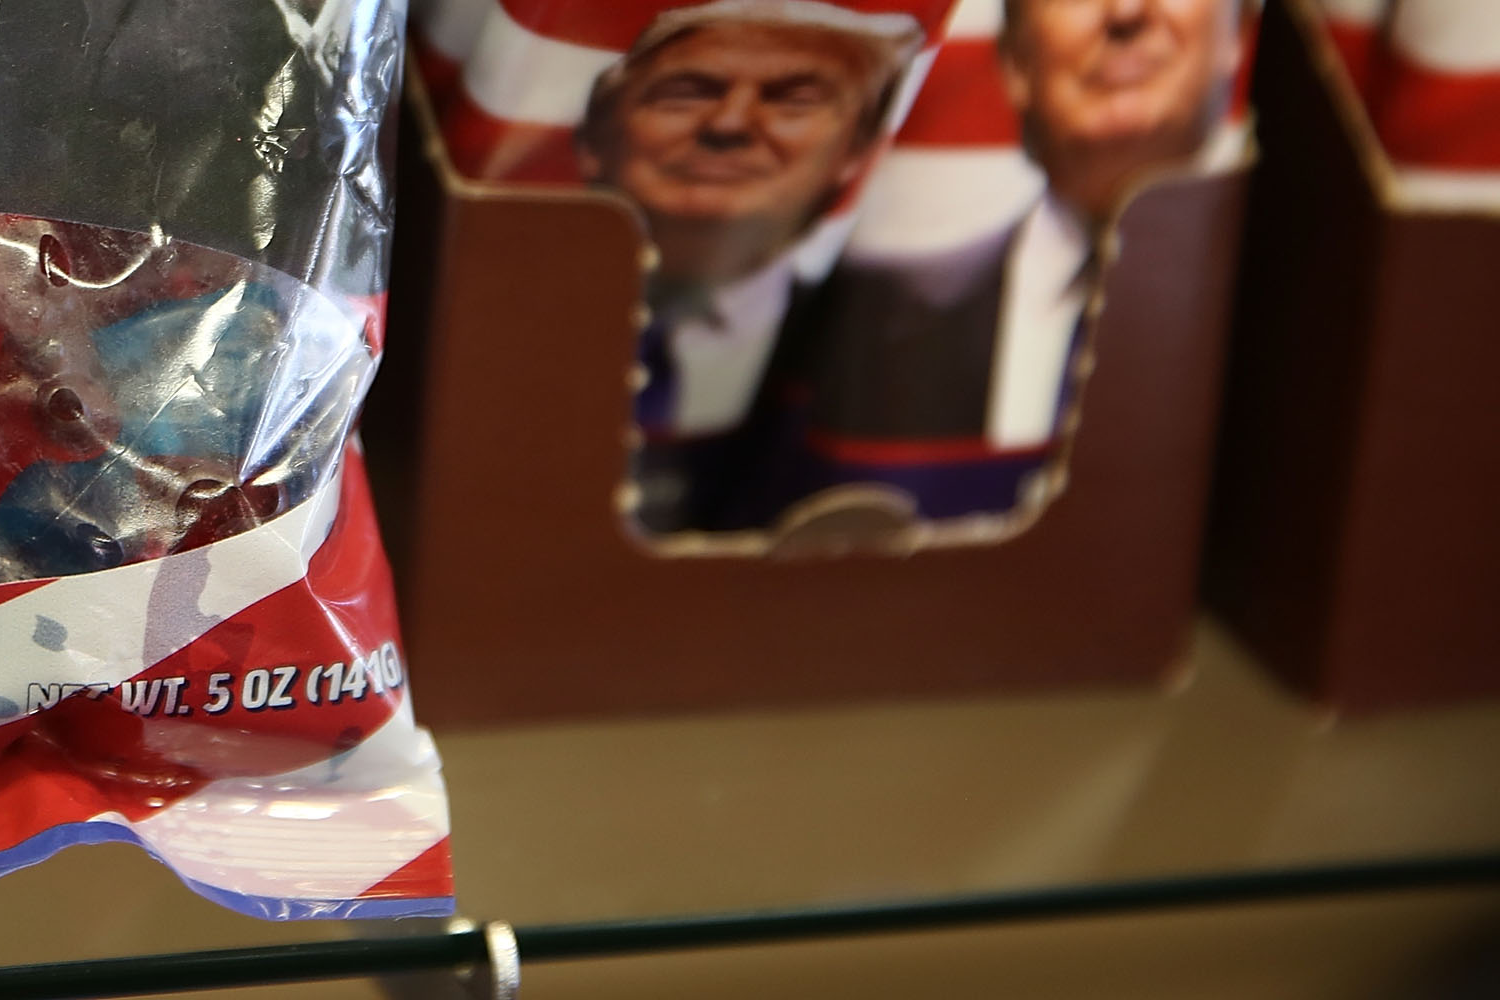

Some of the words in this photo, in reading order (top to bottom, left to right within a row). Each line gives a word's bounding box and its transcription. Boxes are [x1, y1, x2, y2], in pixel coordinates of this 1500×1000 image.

[121, 677, 189, 715] WT.
[203, 672, 231, 712] 5
[242, 666, 297, 709] OZ
